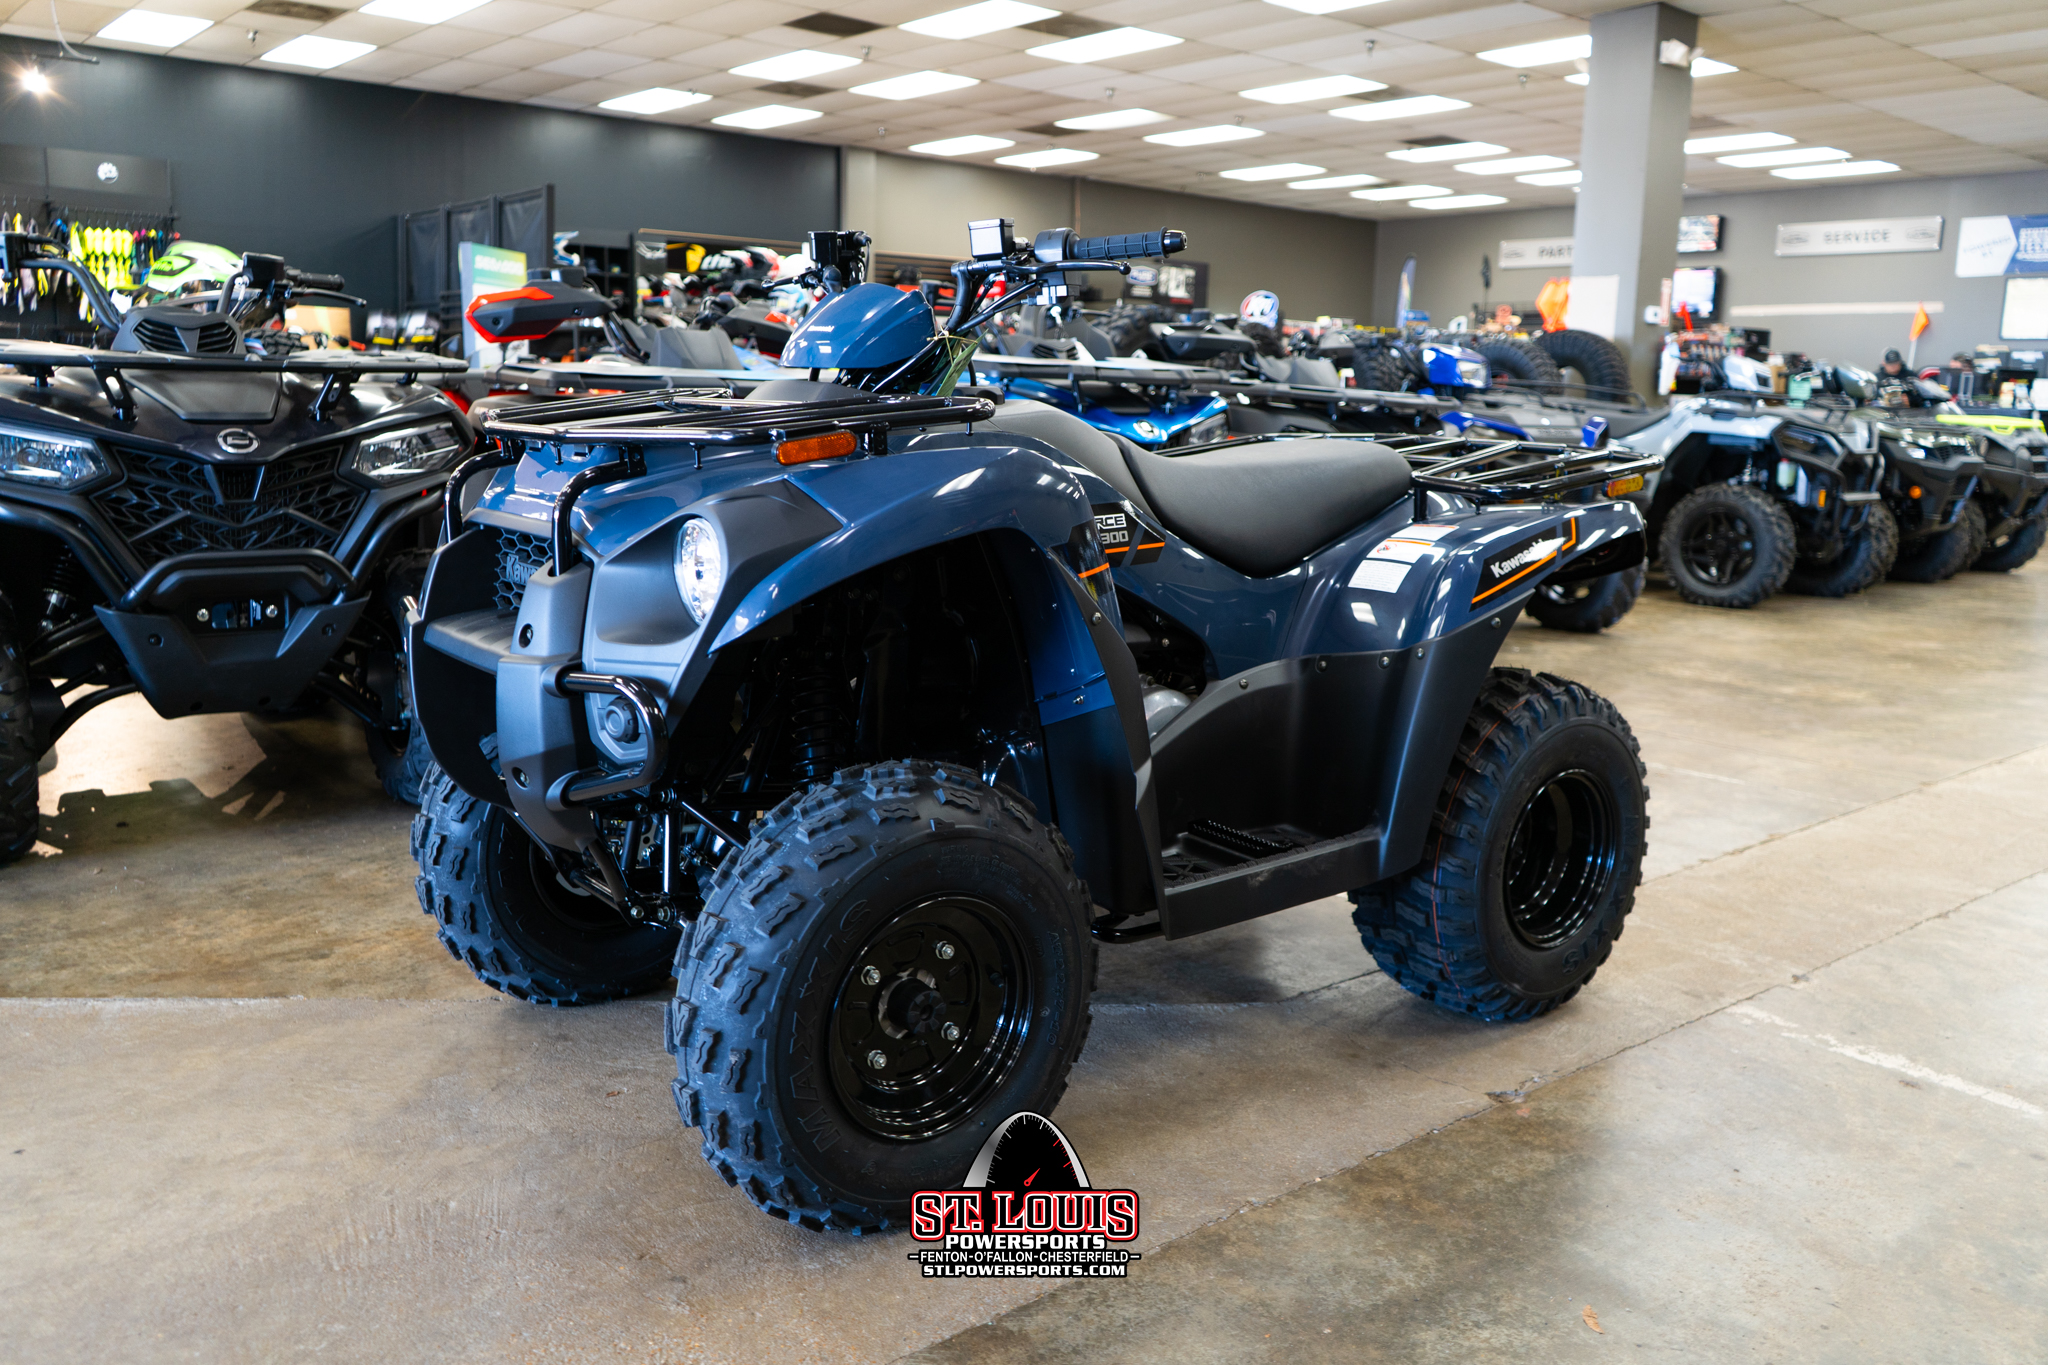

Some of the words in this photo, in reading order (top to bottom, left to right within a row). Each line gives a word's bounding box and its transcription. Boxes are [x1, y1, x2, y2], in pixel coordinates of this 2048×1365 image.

[1823, 229, 1891, 245] SERVICE
[1101, 530, 1129, 544] 300
[790, 899, 872, 1153] MAXXIS
